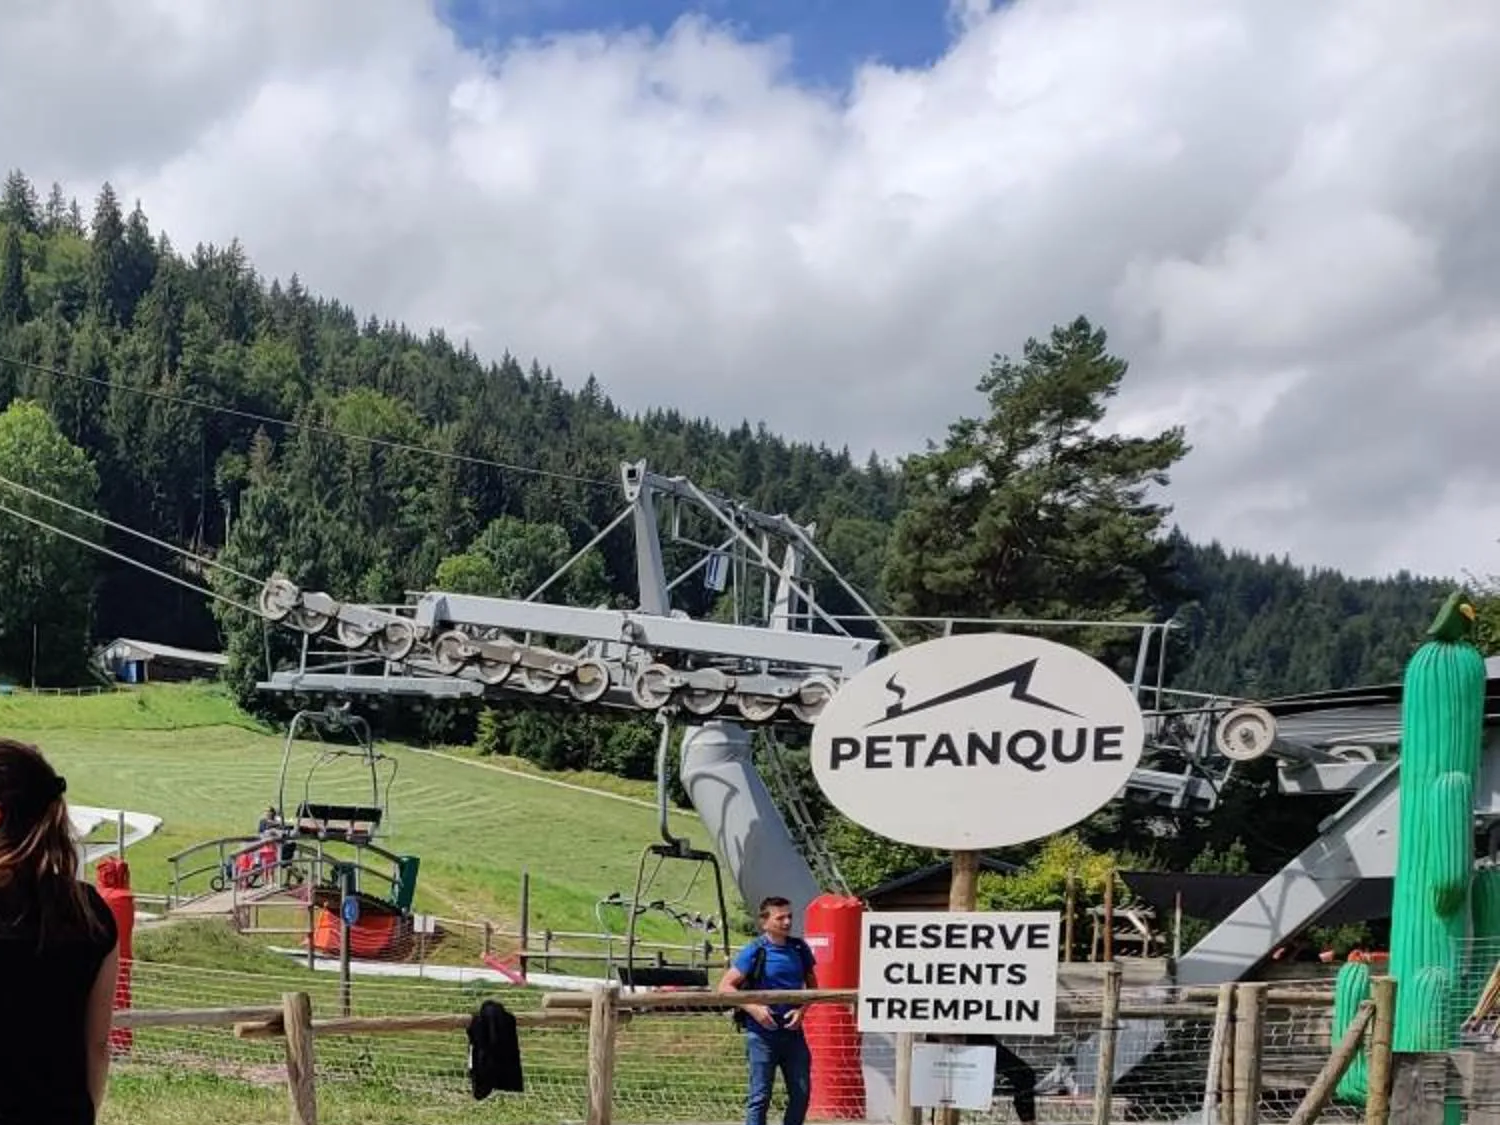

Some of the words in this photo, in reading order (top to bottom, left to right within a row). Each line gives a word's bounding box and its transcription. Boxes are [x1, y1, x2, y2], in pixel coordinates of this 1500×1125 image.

[829, 726, 1124, 772] PETANQUE
[869, 923, 1050, 950] RESERVE
[883, 963, 1027, 985] CLIENTS
[865, 997, 1040, 1022] TREMPLIN
